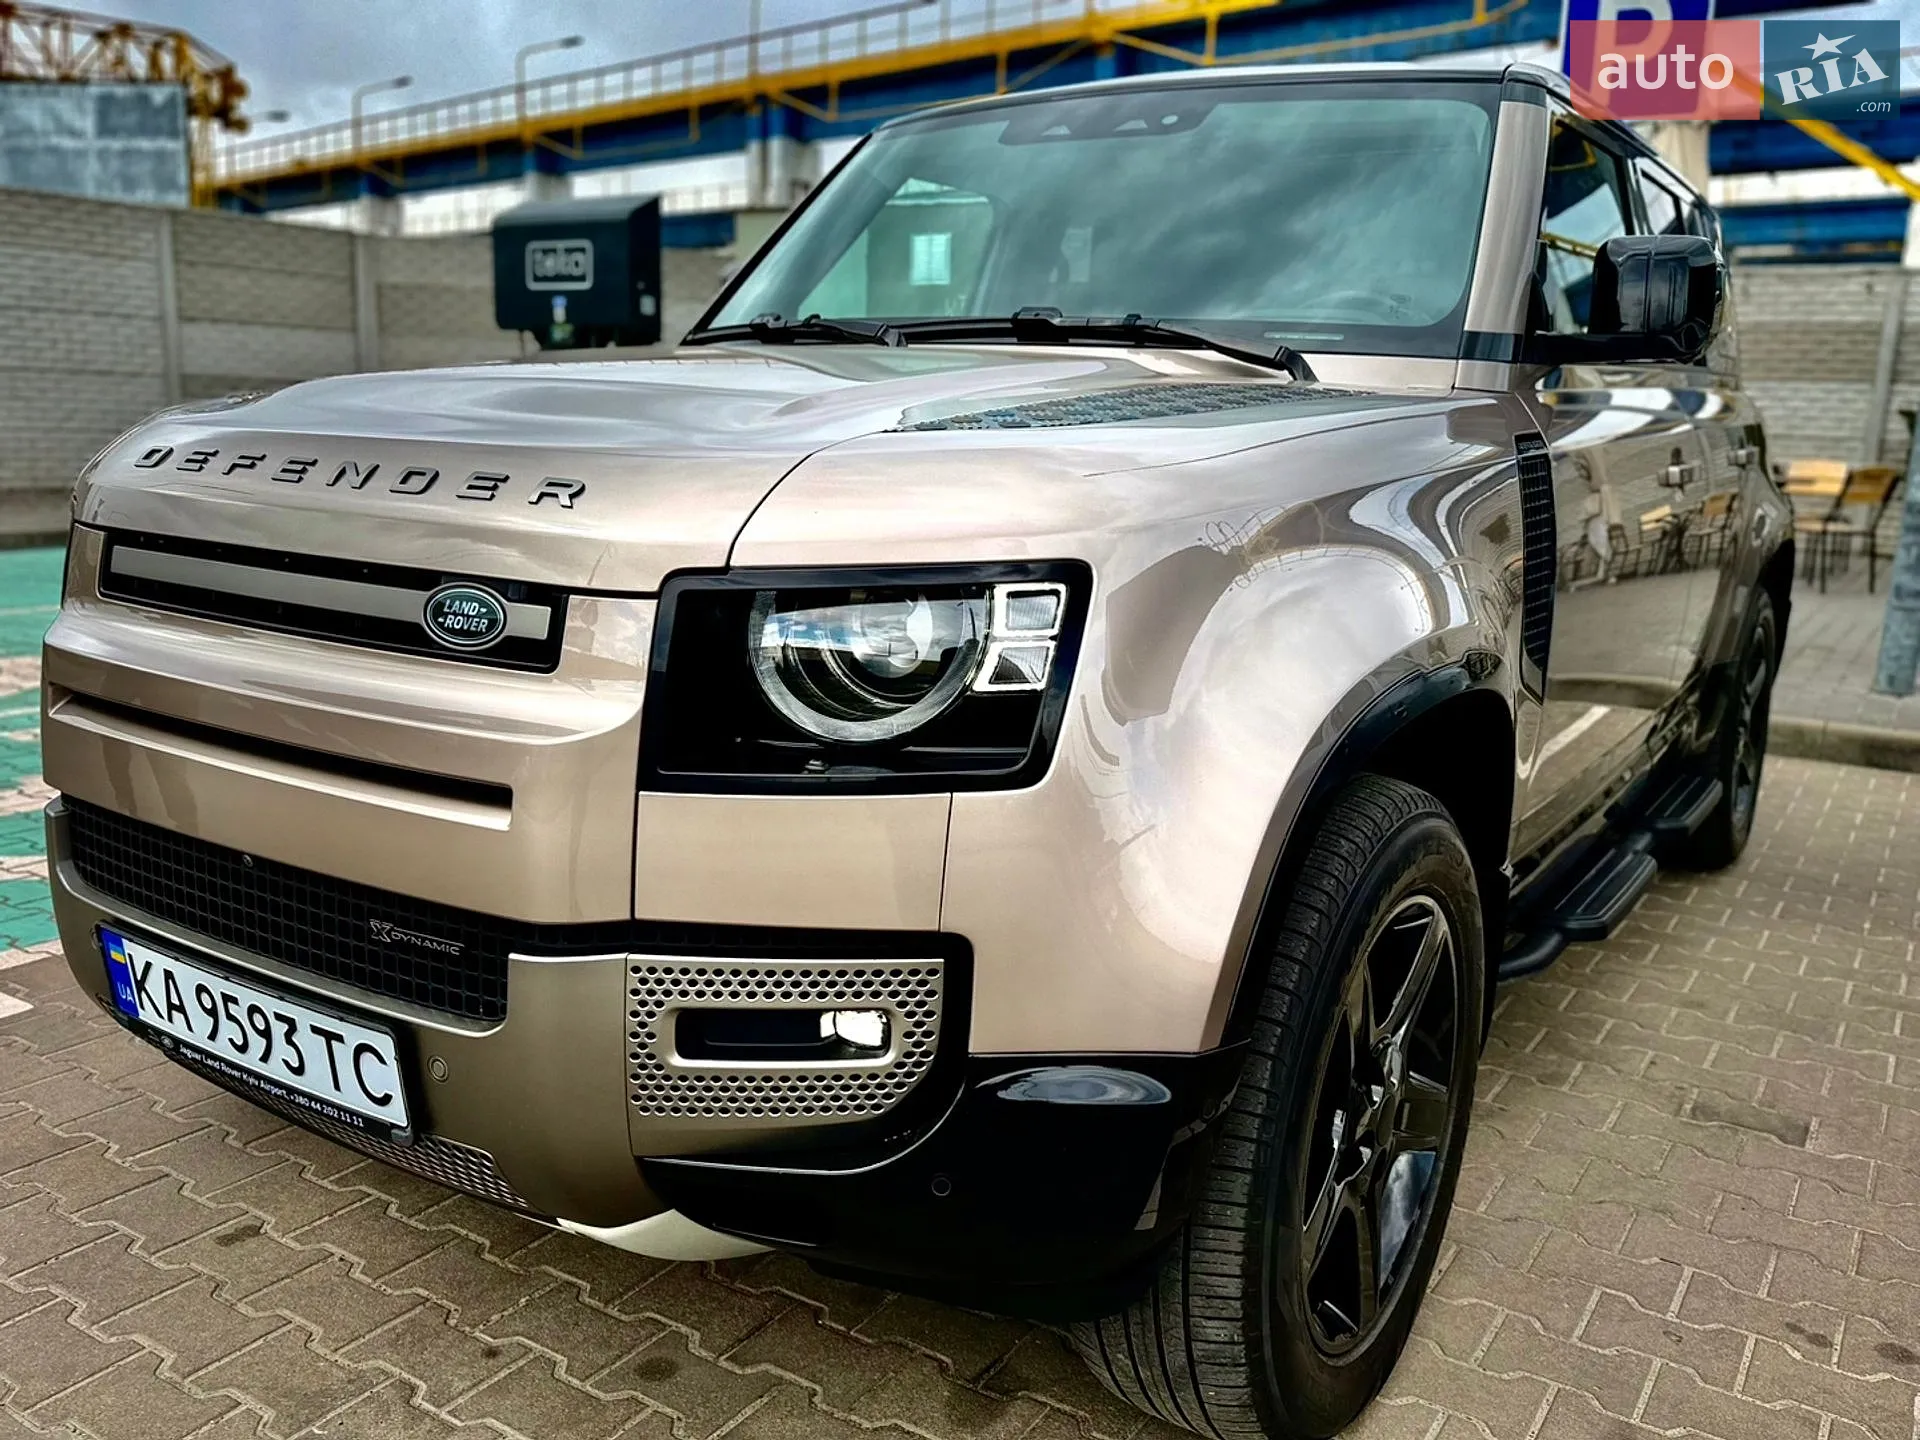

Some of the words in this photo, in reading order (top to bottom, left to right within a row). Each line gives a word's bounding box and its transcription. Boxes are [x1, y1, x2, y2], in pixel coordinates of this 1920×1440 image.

[134, 445, 586, 509] DEFENDER
[117, 981, 135, 1004] UA
[179, 1043, 202, 1062] Jaguar
[202, 1053, 220, 1071] Land
[220, 1061, 242, 1079] Rover
[310, 1101, 322, 1112] 44
[322, 1104, 340, 1118] 202
[340, 1110, 352, 1123] 11
[352, 1115, 365, 1128] 11
